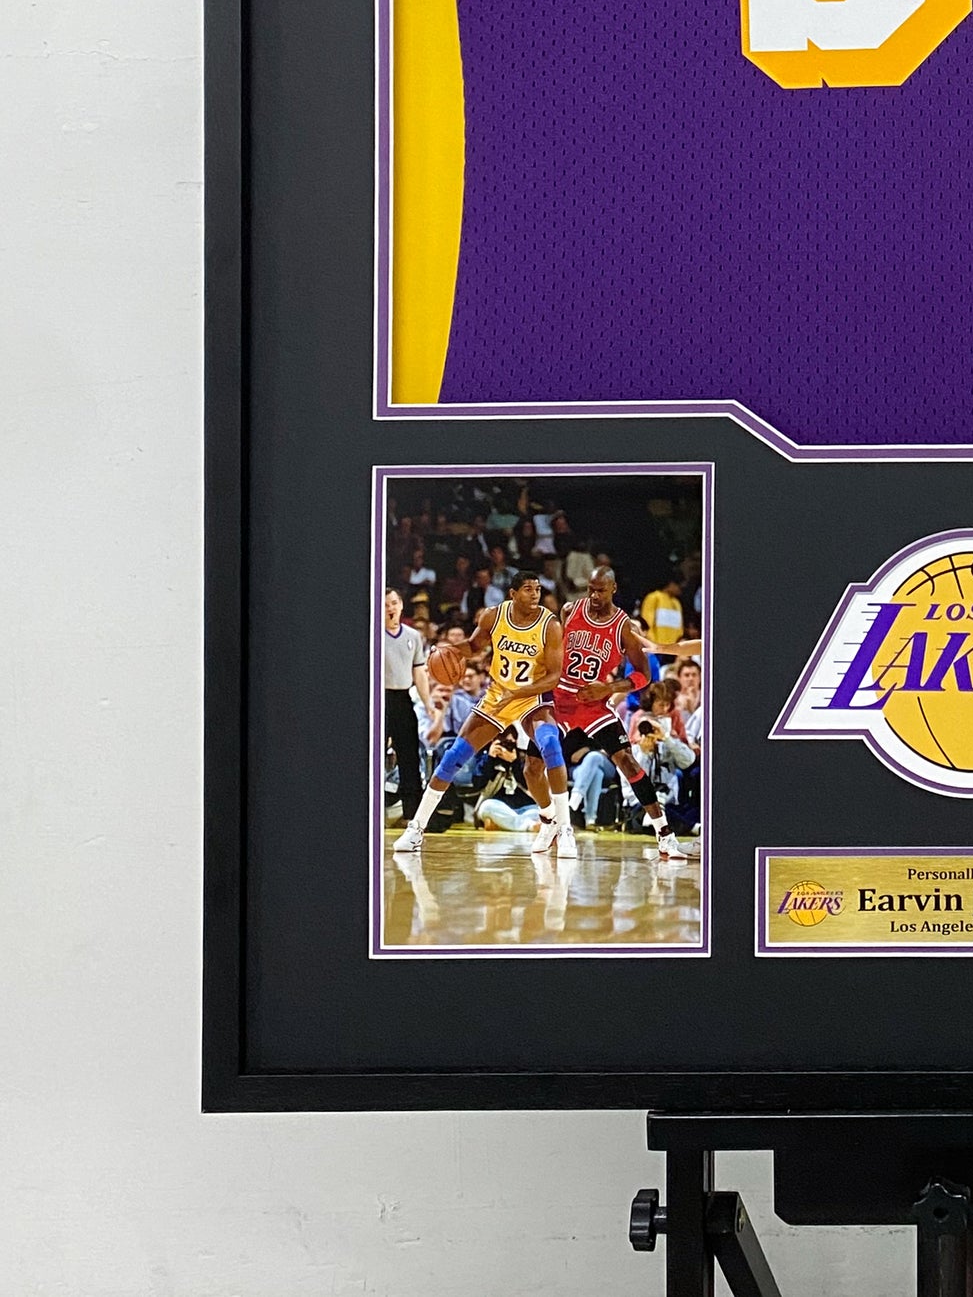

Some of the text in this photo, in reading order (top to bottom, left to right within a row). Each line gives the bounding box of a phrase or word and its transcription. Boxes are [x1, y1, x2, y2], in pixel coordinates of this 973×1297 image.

[498, 635, 539, 656] LAKERS
[567, 630, 612, 662] BULLS
[499, 655, 533, 686] 32
[567, 651, 602, 682] 23
[777, 891, 847, 916] LAKERS
[858, 888, 964, 912] Earvin
[890, 921, 917, 932] Los
